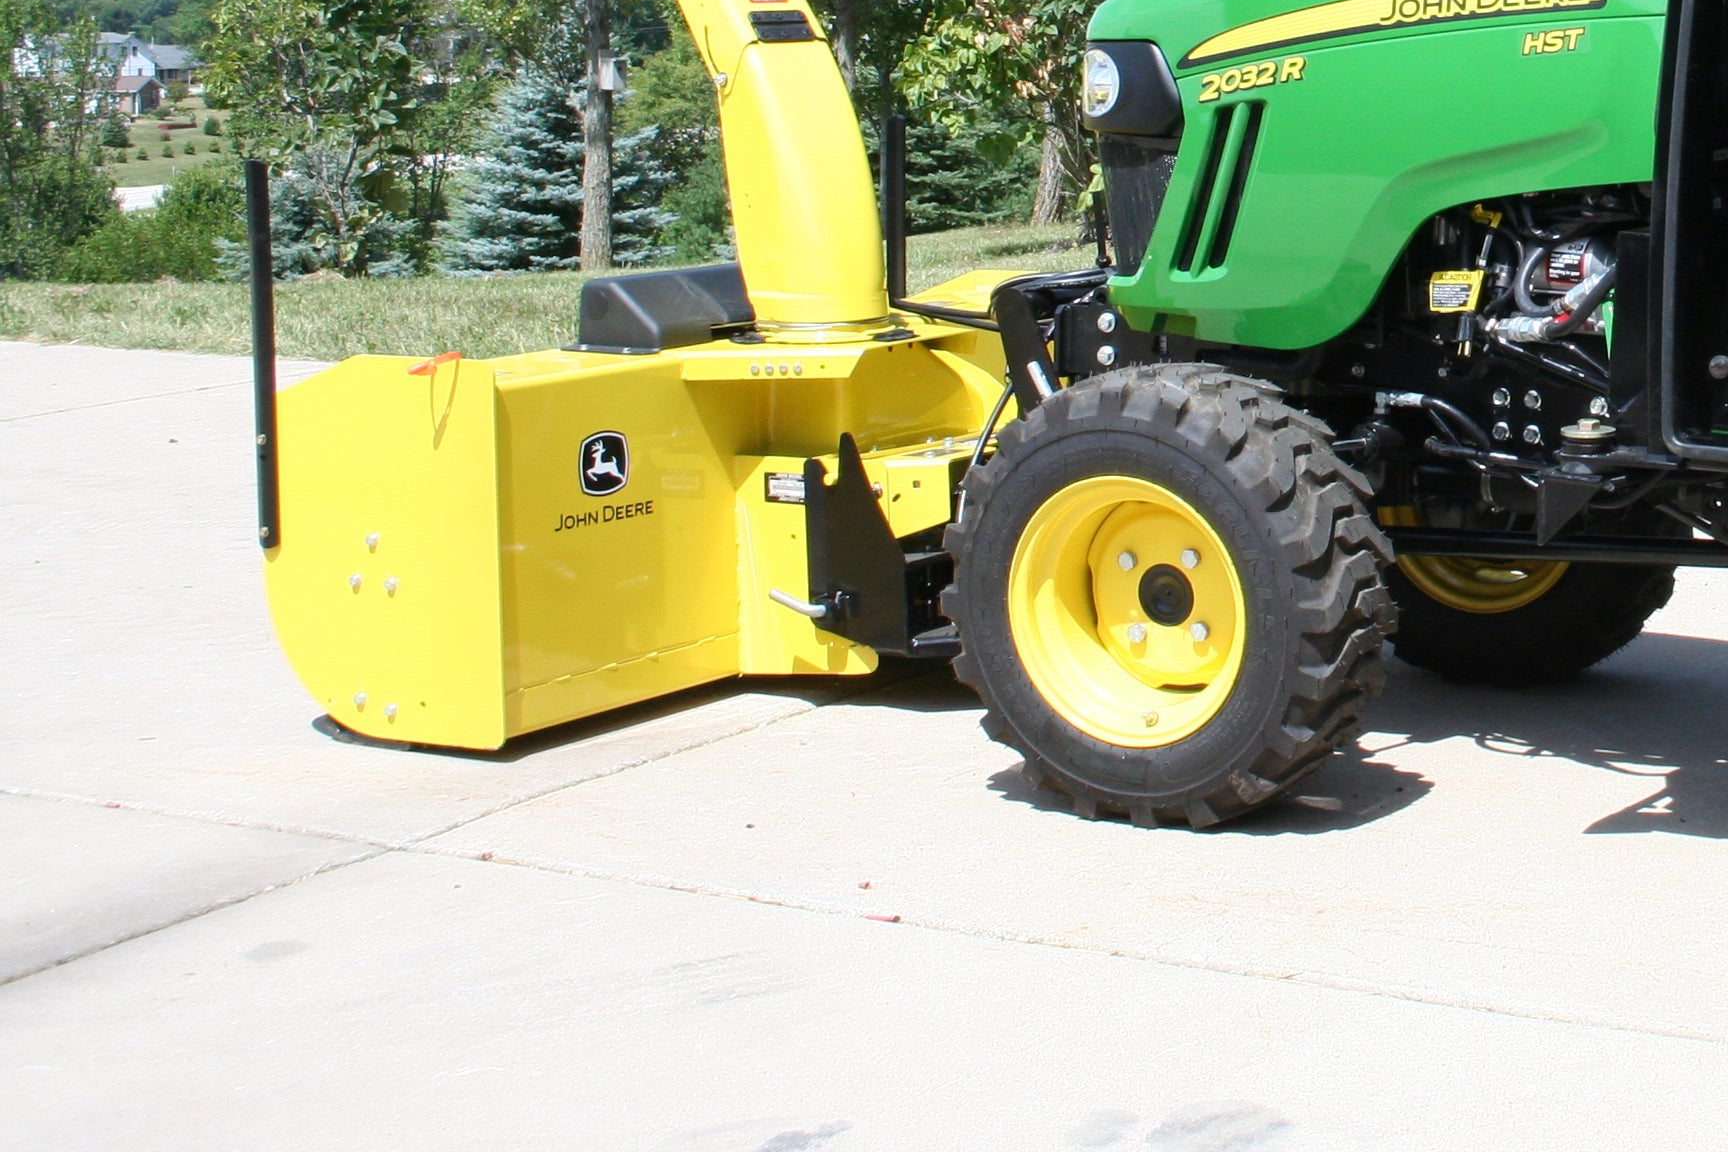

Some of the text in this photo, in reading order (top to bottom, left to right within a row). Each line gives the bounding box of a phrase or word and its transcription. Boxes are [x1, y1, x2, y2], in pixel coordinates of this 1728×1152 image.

[1521, 26, 1586, 56] HST
[554, 499, 654, 533] JOHN DEERE
